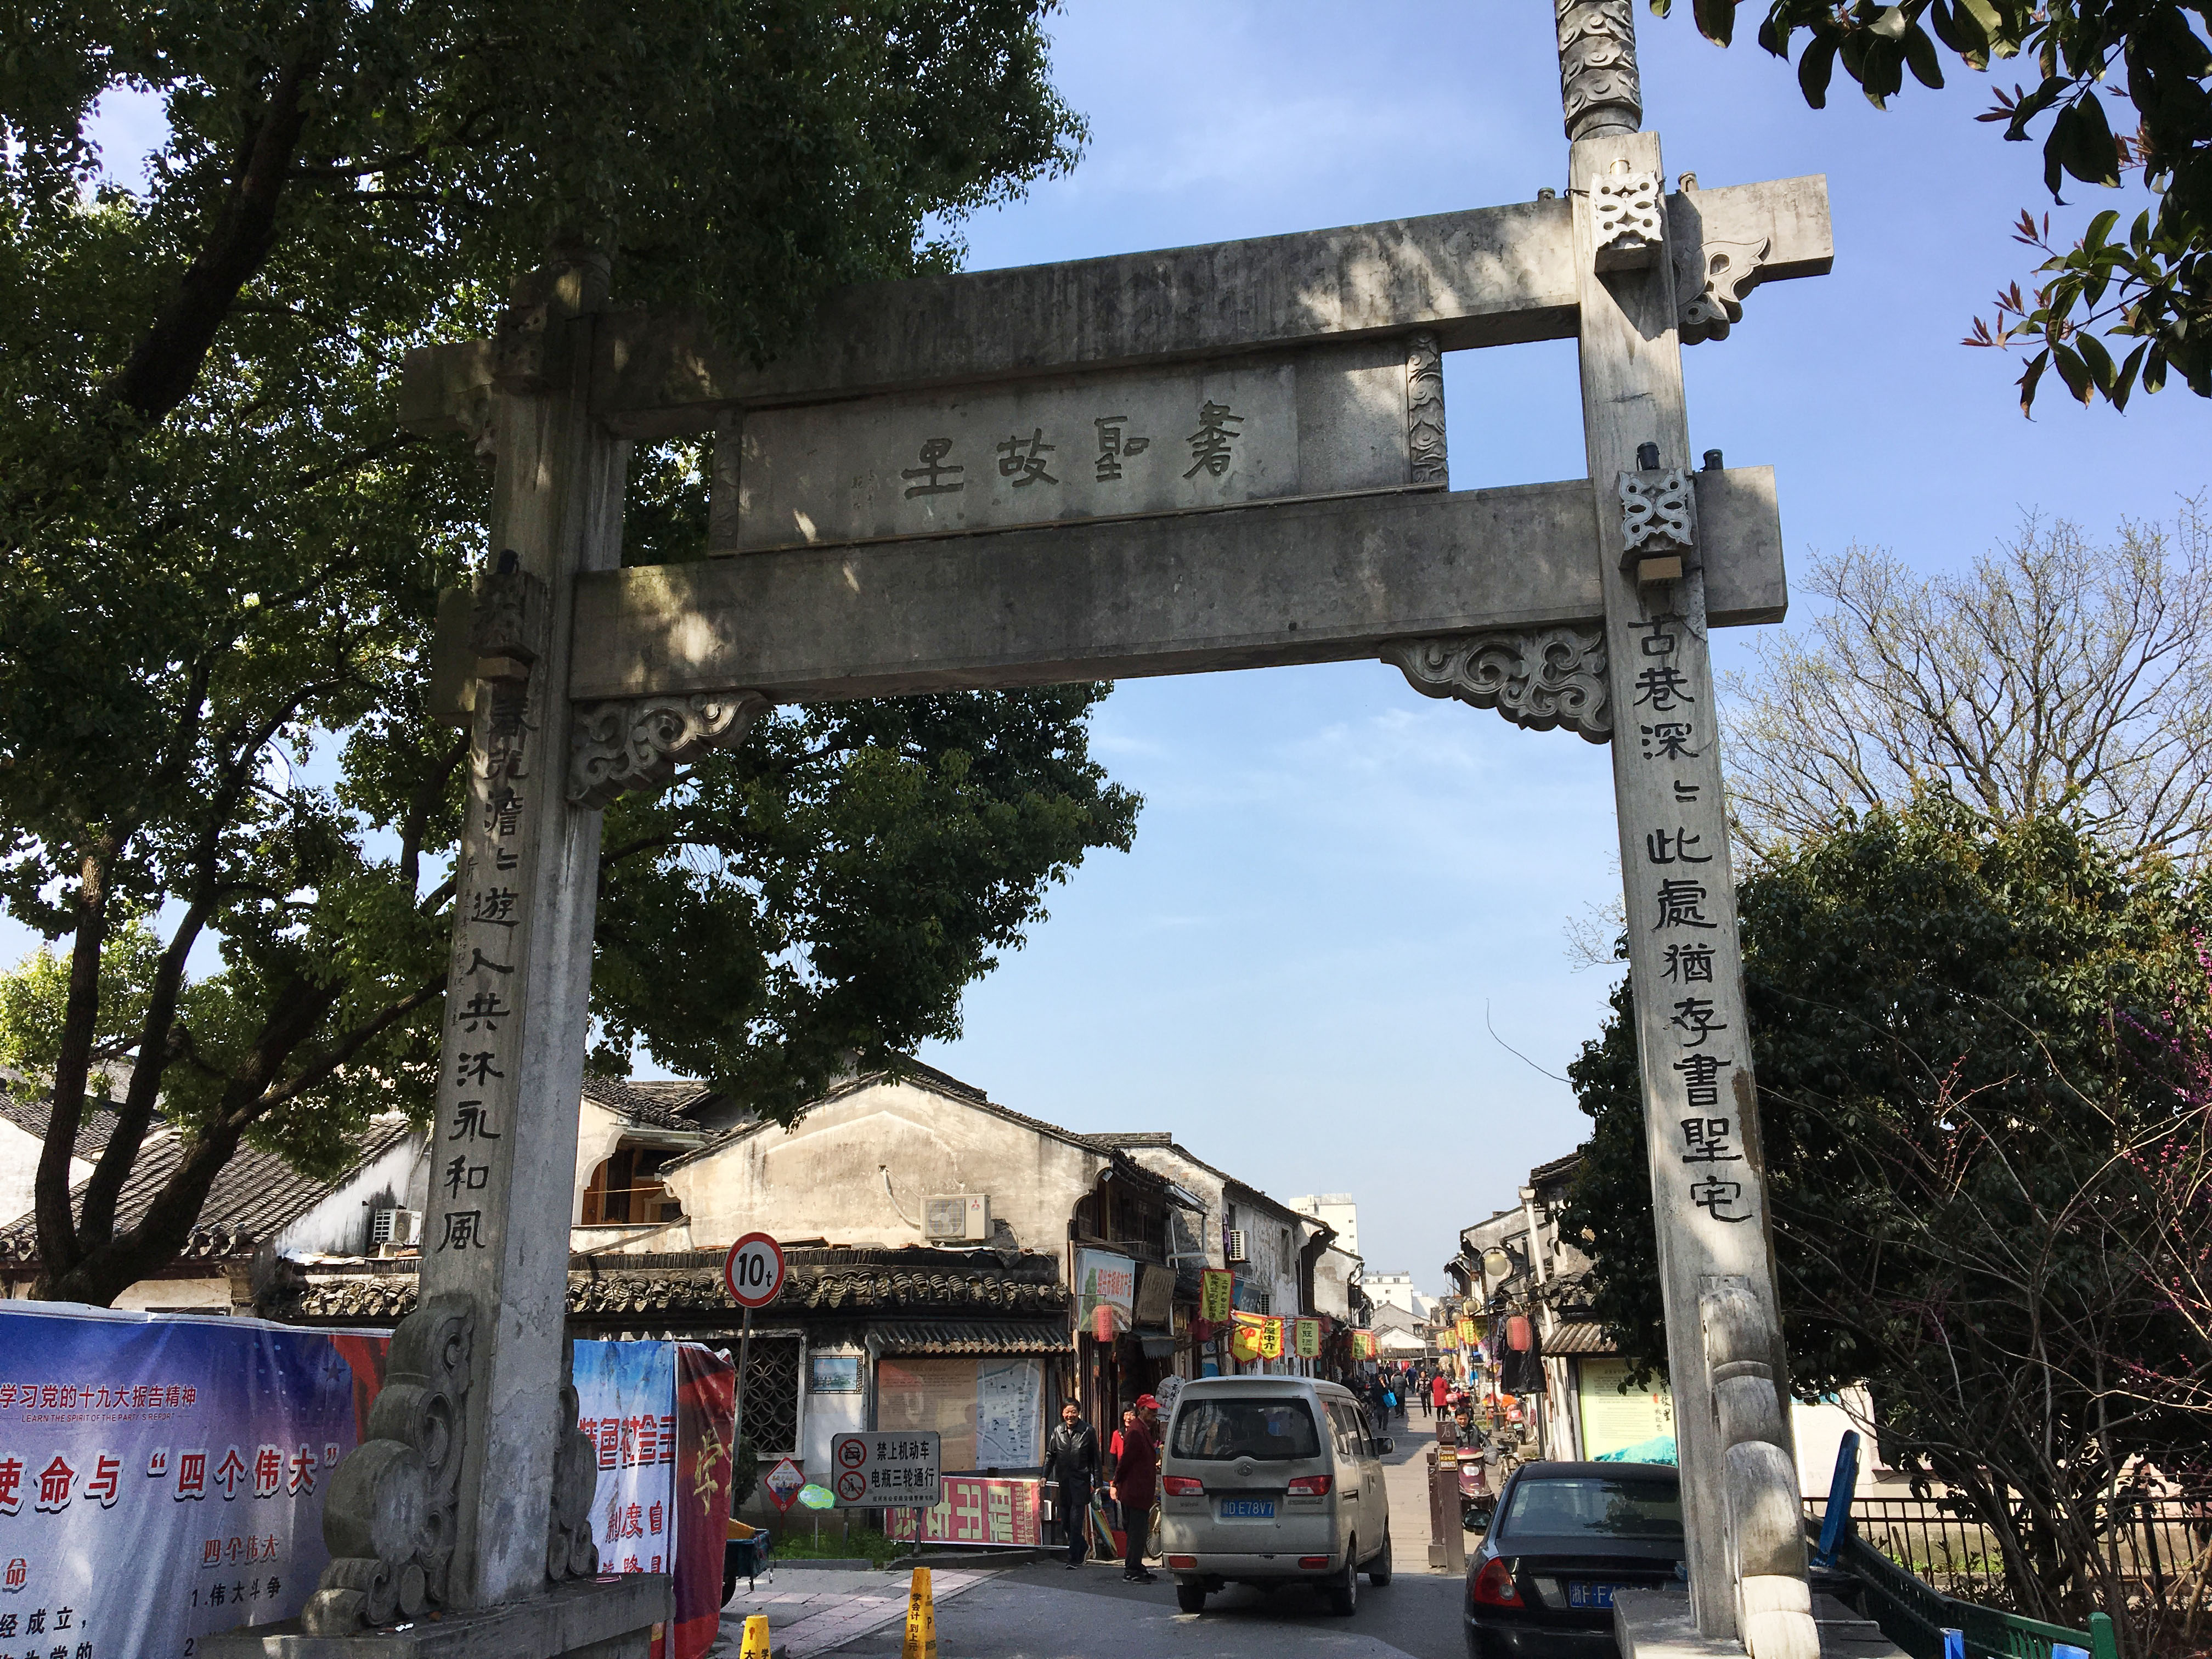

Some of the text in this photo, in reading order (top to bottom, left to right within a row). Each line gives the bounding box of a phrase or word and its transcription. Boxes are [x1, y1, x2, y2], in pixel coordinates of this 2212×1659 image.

[1263, 1319, 1276, 1350] 房屋中介
[1302, 1322, 1313, 1355] 顶旺酒楼
[1, 1383, 196, 1409] 学习党的十九大报告精神
[21, 1414, 48, 1423] LEARN
[50, 1414, 65, 1422] THE
[66, 1413, 89, 1422] SPIRIT
[91, 1413, 102, 1421] OF
[103, 1413, 116, 1421] THE
[871, 1468, 935, 1488] 电瓶三轮通行
[204, 1534, 279, 1564] 四个伟大
